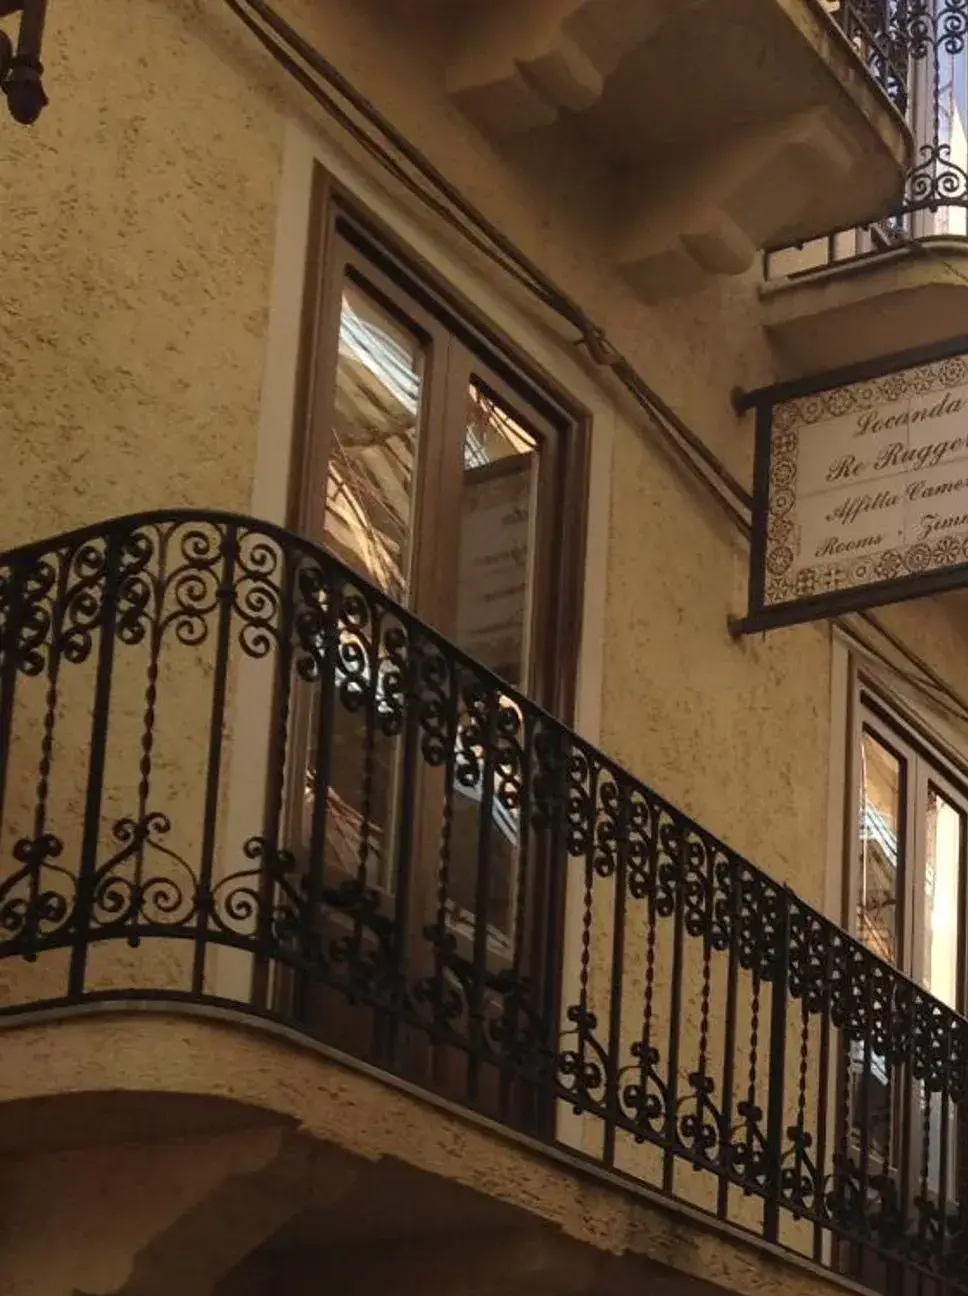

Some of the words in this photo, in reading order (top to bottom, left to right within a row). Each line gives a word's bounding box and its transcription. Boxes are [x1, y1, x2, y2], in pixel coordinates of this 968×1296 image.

[852, 391, 967, 438] Locanda
[825, 453, 867, 483] Re
[815, 533, 885, 558] Rooms
